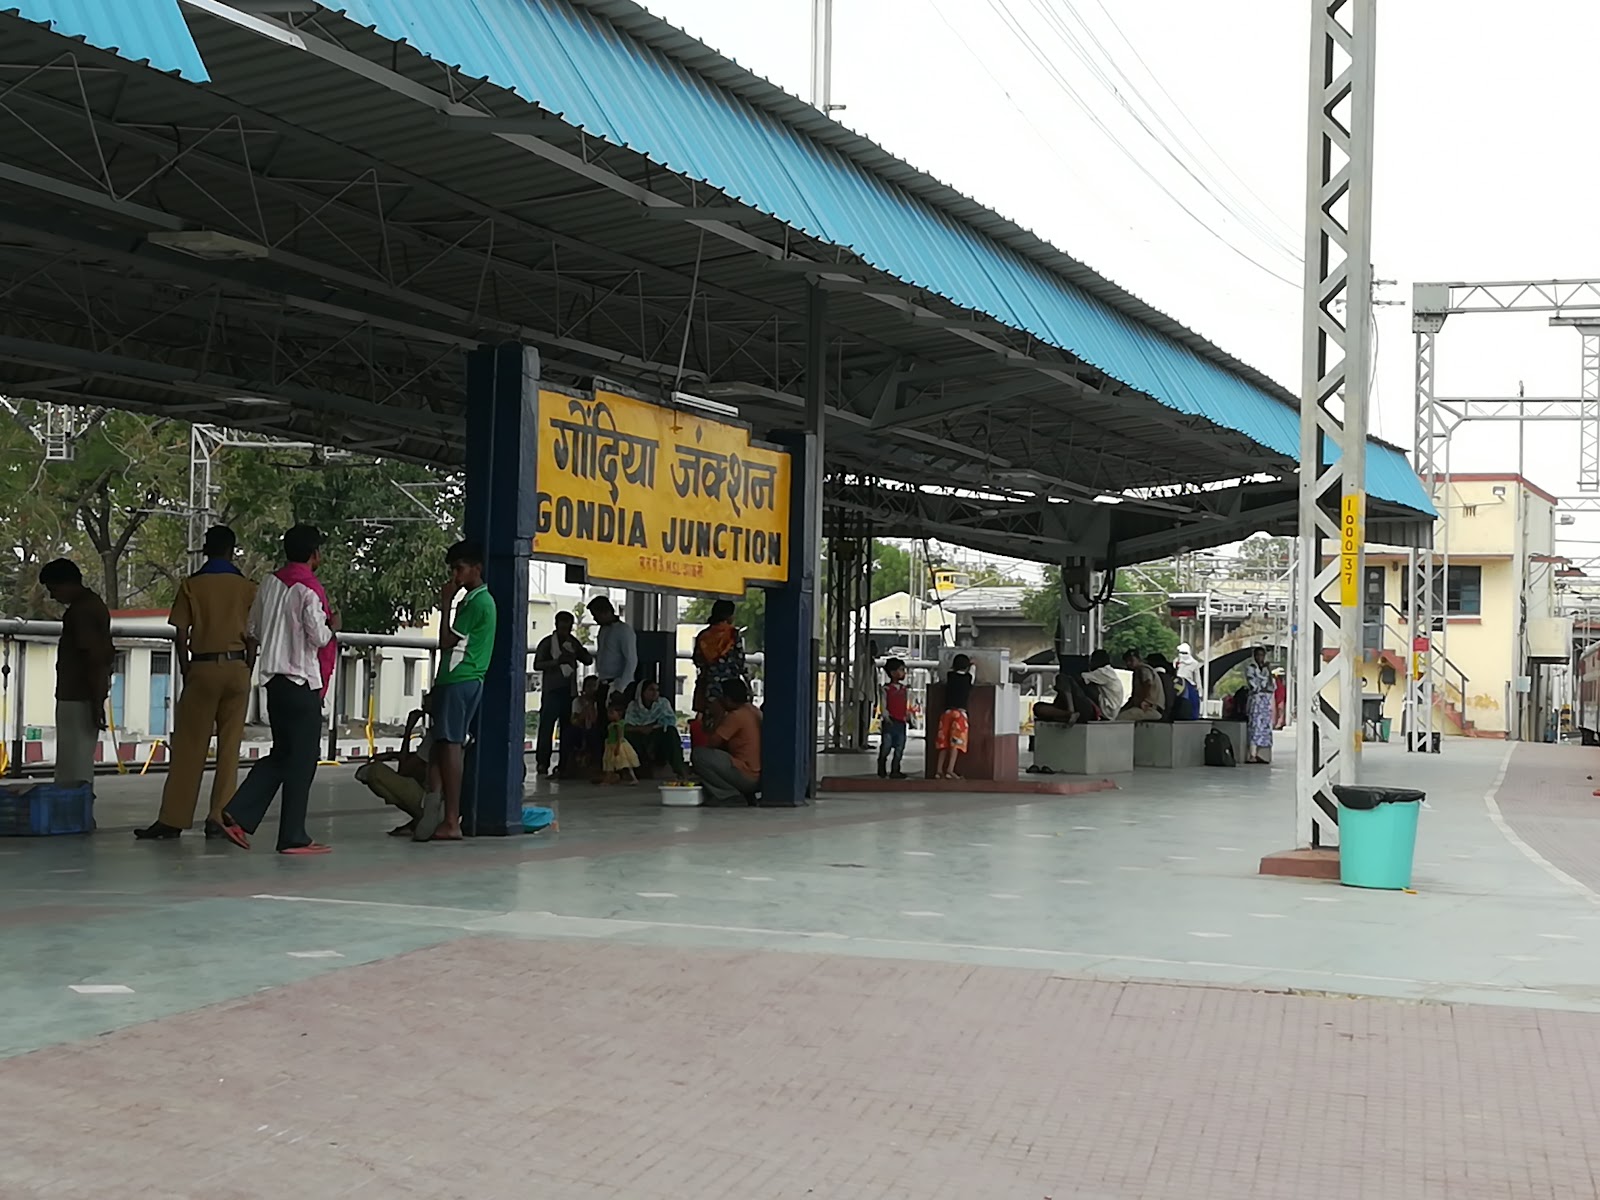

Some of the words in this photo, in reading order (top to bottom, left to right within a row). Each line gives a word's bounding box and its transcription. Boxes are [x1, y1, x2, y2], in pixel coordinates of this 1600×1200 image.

[549, 400, 660, 505] गोंदिया
[537, 492, 648, 549] GONDIA
[662, 517, 782, 566] JUNCTION
